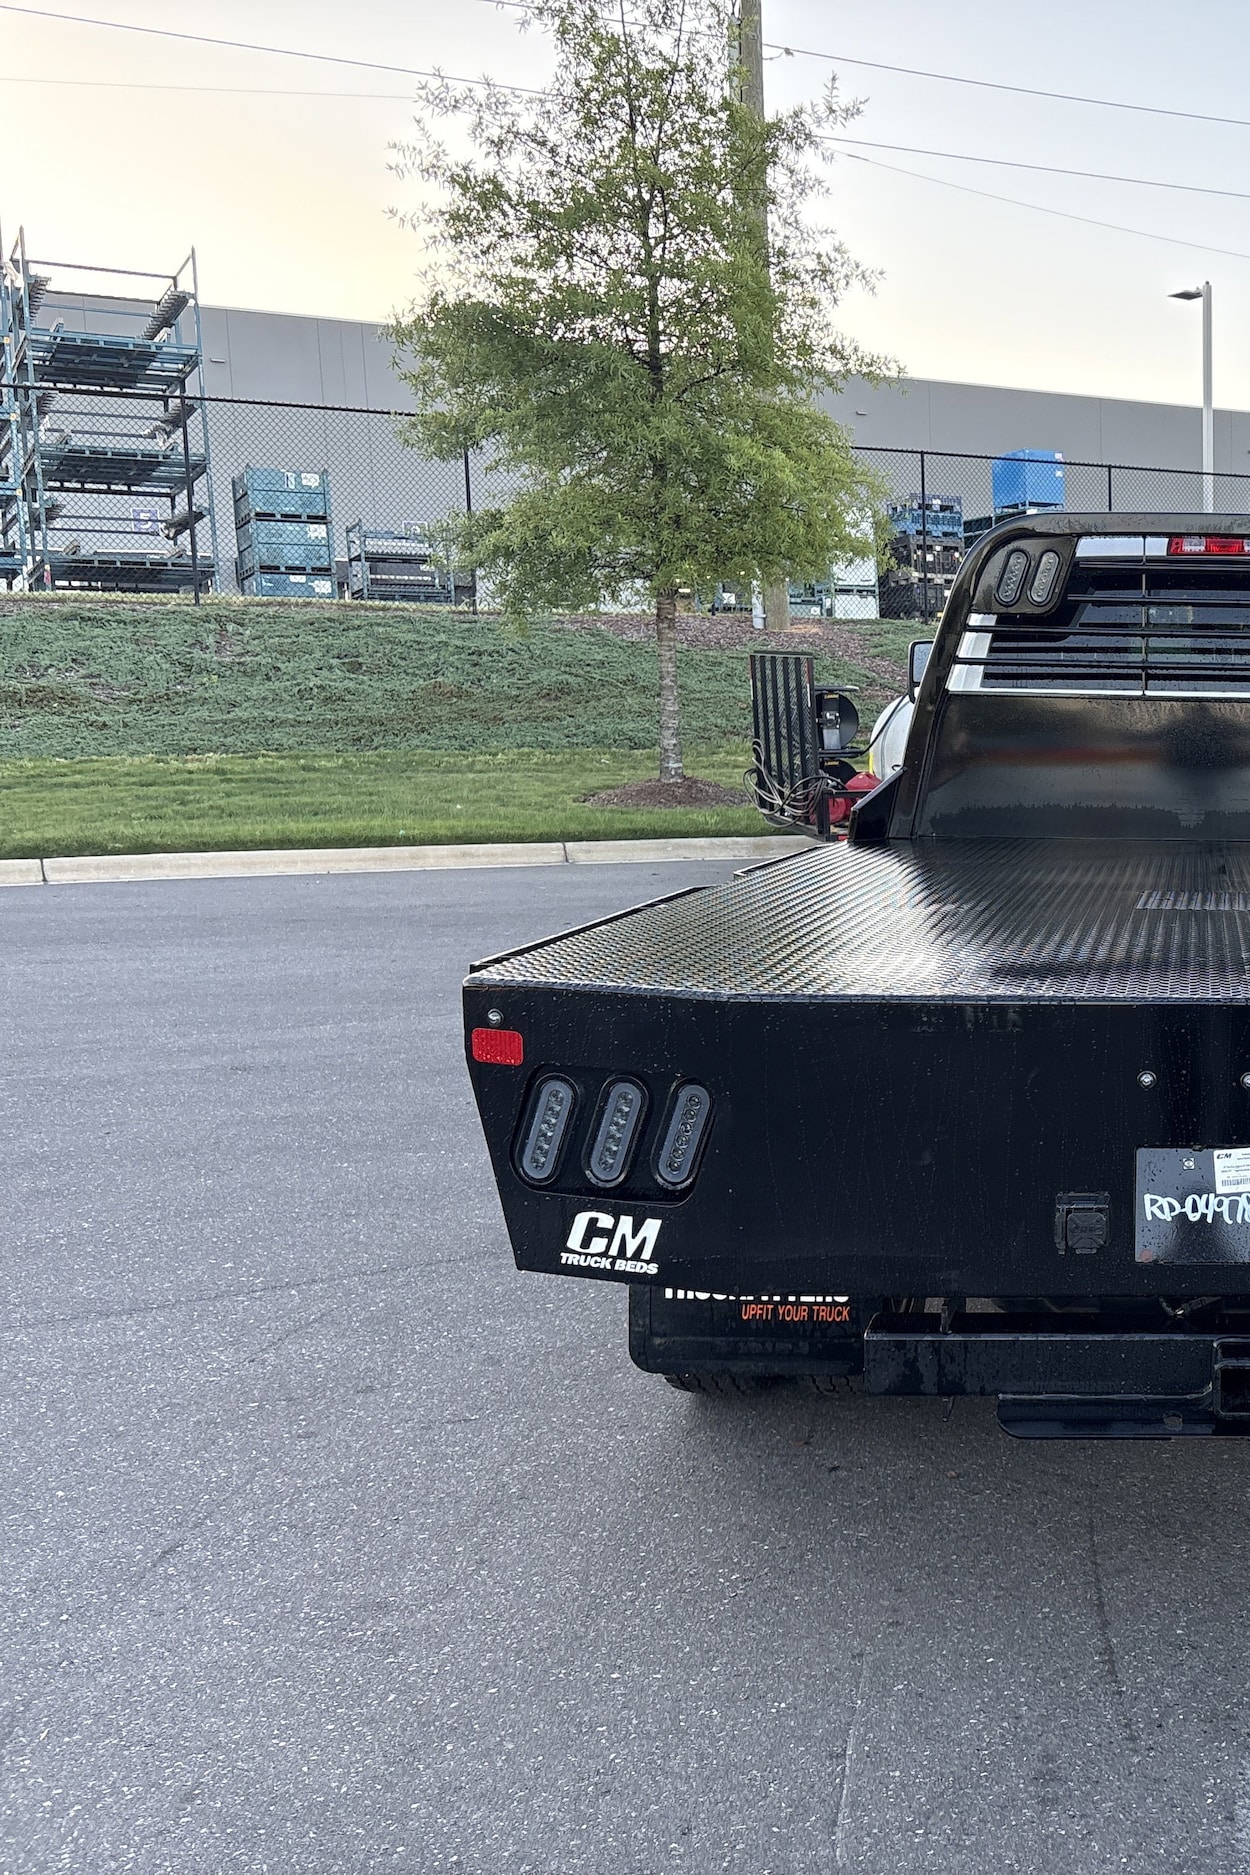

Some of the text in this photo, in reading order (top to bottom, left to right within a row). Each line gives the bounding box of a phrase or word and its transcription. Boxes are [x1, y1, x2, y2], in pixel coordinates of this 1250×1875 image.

[566, 1211, 662, 1260] CM
[560, 1252, 659, 1275] TRUCK BEDS
[742, 1304, 850, 1322] UPFIT YOUR TRUCK
